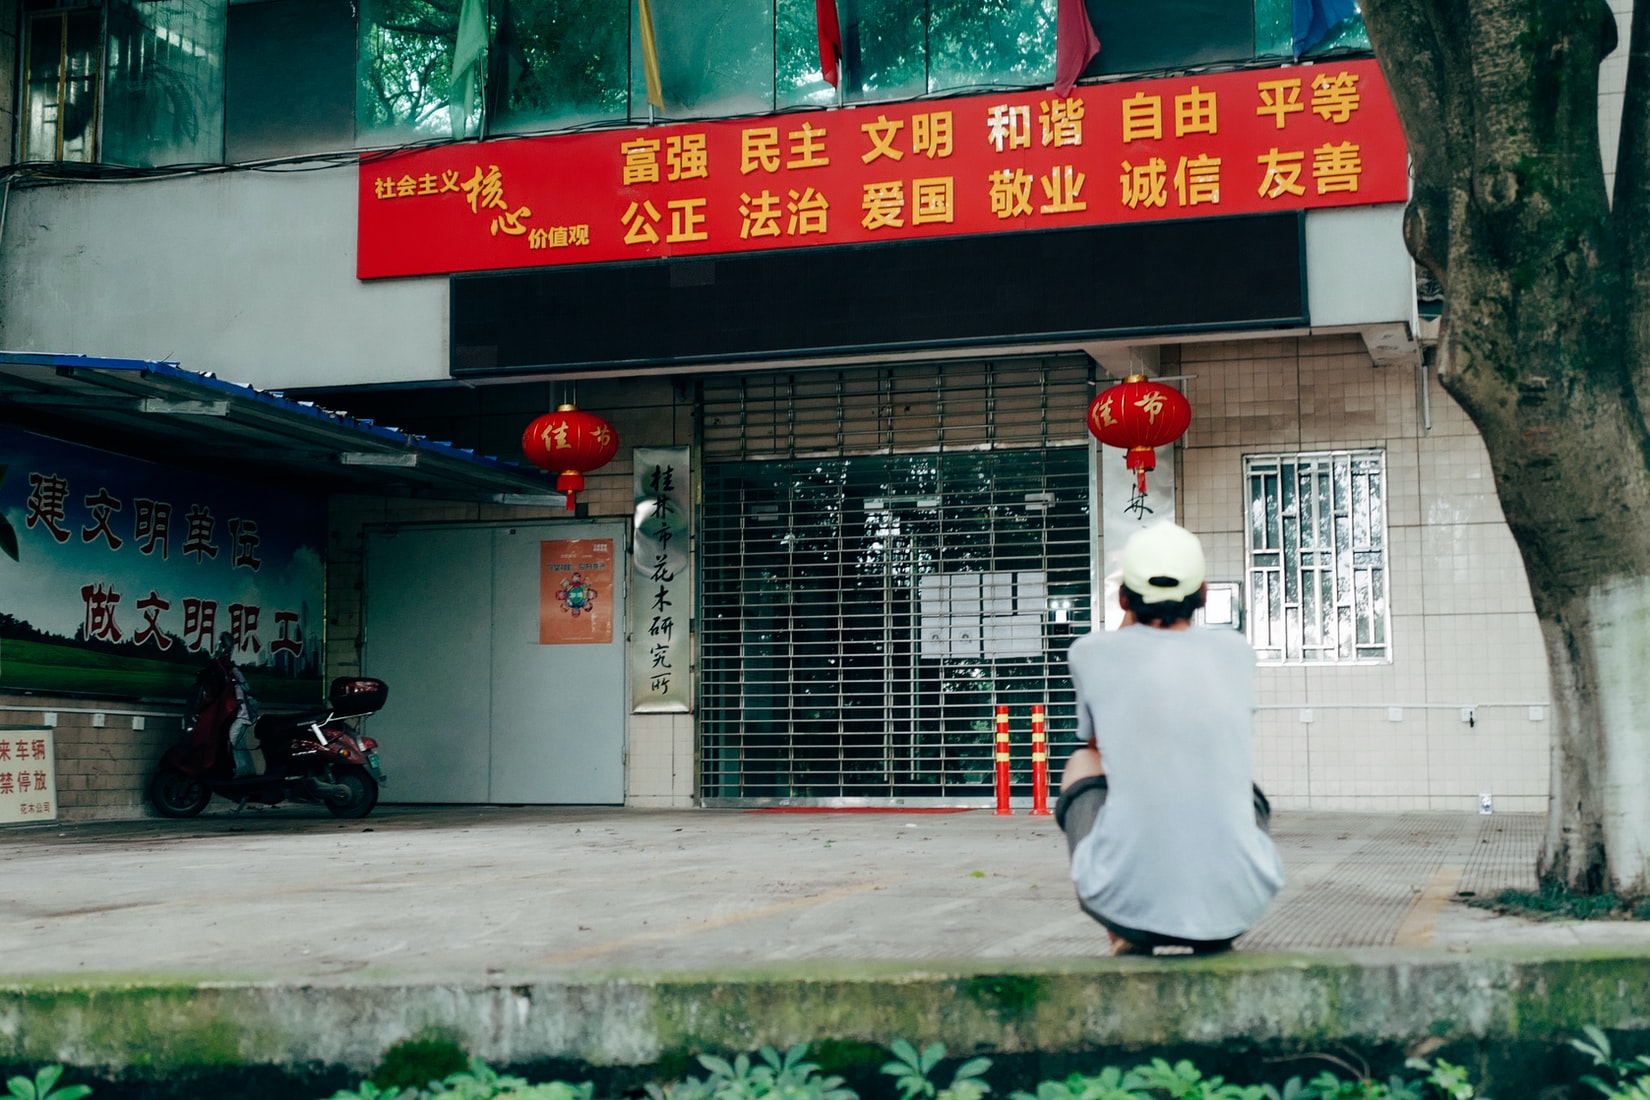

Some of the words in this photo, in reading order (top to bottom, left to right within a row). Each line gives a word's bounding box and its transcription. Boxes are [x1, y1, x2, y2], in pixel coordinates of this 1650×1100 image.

[621, 133, 708, 186] 富强
[740, 121, 830, 175] 民主
[861, 110, 953, 164] 文明
[987, 97, 1085, 153] 和谐
[1122, 86, 1218, 143] 自由
[1256, 71, 1360, 129] 平等
[374, 169, 460, 200] 社会主义
[528, 224, 590, 250] 价值观
[620, 197, 708, 245] 公正
[738, 187, 830, 239] 法治
[861, 176, 954, 230] 爱国
[988, 165, 1087, 219] 敬业
[1119, 153, 1222, 209] 诚信
[1257, 141, 1362, 199] 友善
[26, 472, 262, 572] 建文明单位
[80, 583, 303, 657] 做文明职工
[647, 464, 676, 695] 桂林市花木研究所
[0, 770, 47, 795] 禁停放
